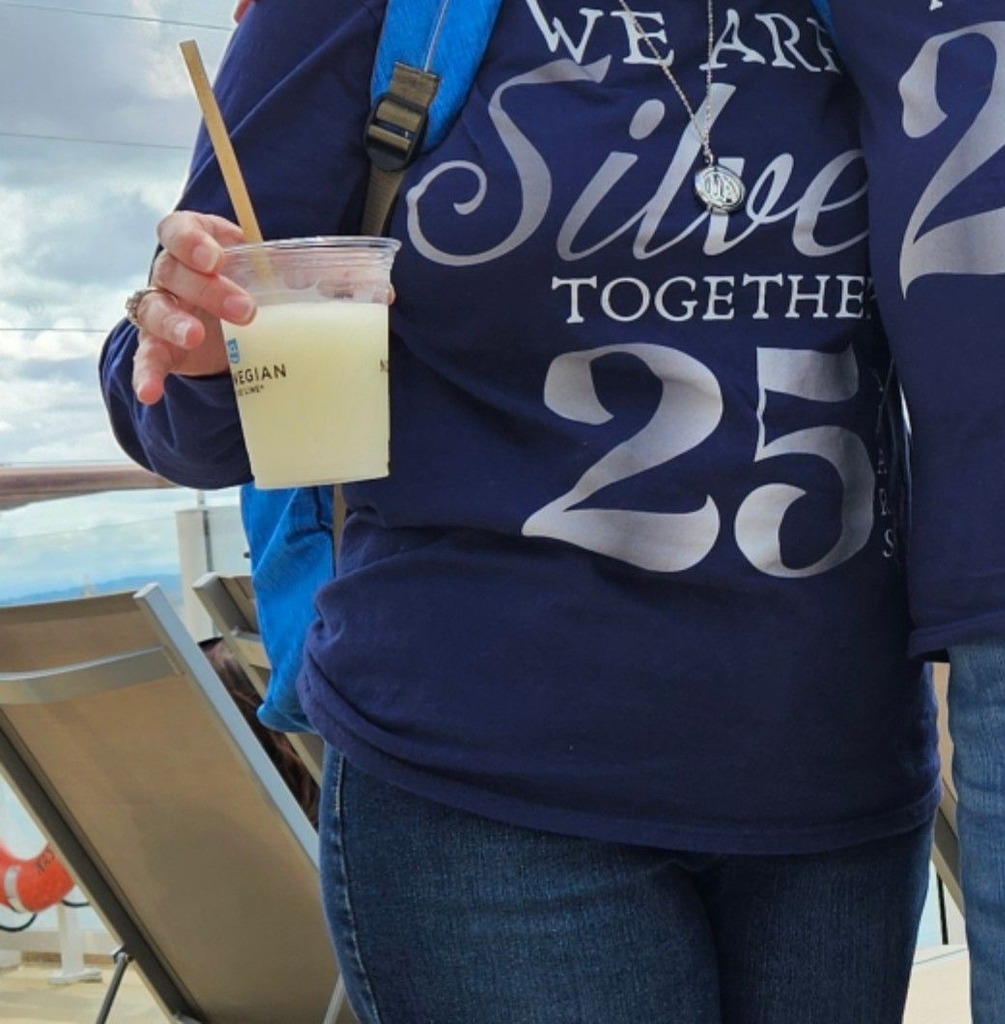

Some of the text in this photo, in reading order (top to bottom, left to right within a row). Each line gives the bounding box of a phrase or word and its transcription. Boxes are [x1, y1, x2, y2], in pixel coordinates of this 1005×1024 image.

[406, 53, 870, 267] Silve
[551, 274, 877, 324] TOGETHE
[233, 363, 287, 386] EGIAN
[521, 342, 876, 579] 25
